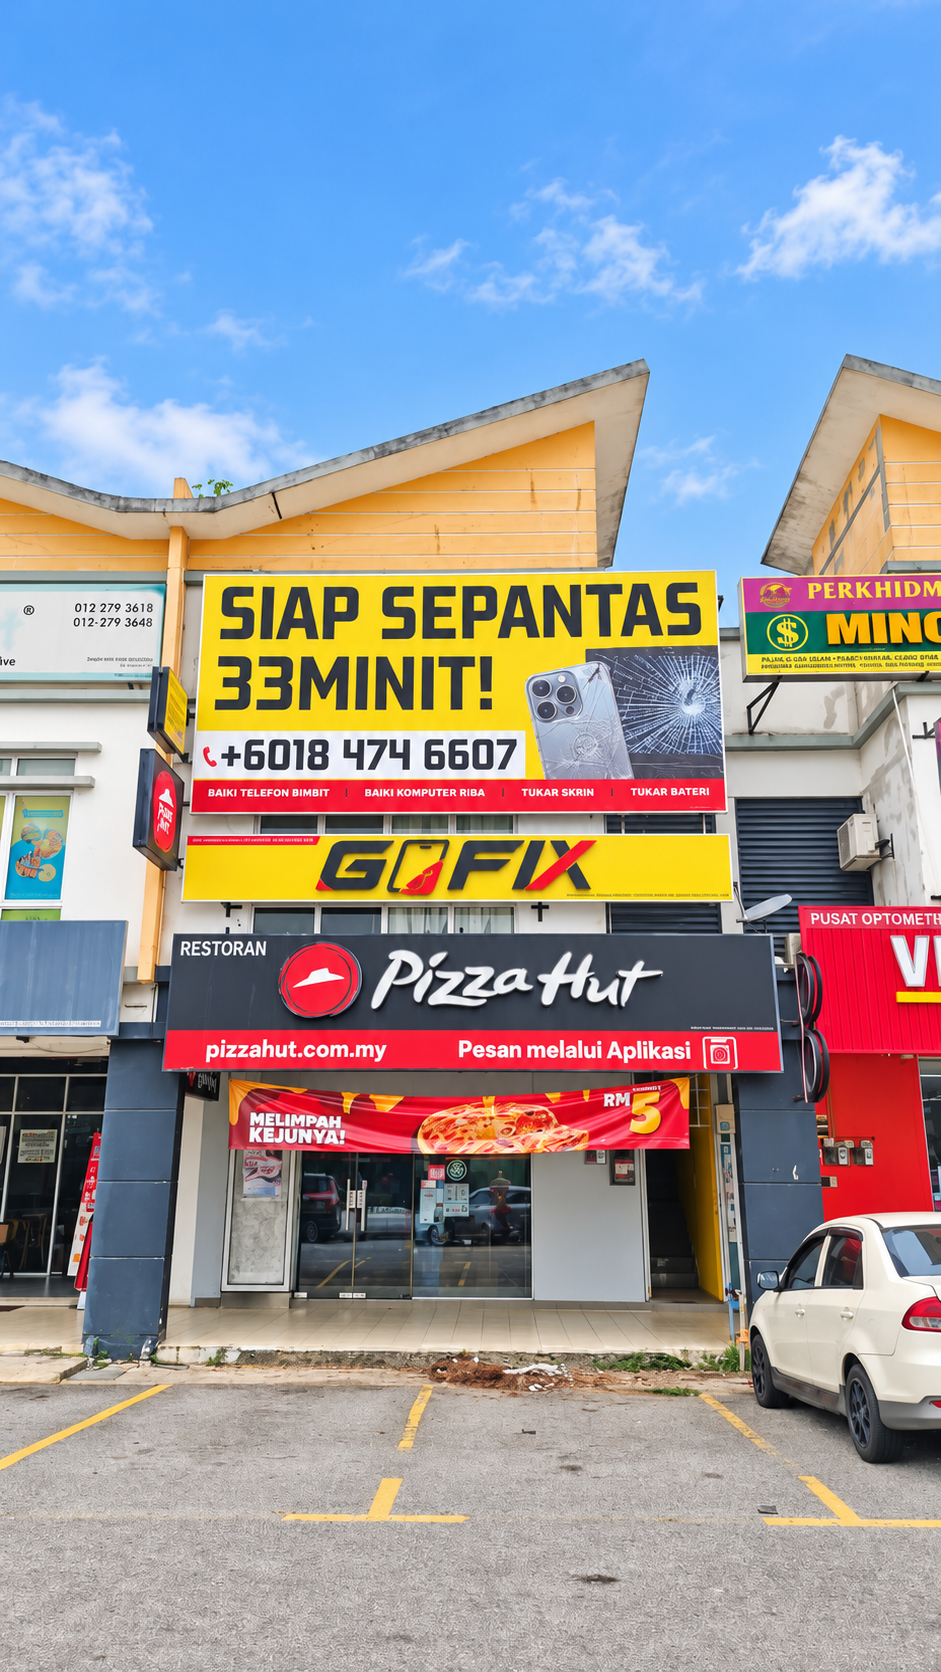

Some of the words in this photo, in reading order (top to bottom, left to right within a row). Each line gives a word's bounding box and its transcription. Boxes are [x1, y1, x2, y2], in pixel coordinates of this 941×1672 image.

[74, 603, 96, 613] 012
[100, 603, 121, 613] 279
[125, 603, 154, 613] 3618
[220, 586, 359, 640] SIAP
[382, 582, 701, 640] SEPANTAS
[124, 617, 153, 628] 3648
[214, 656, 492, 711] 33MINIT!
[221, 738, 330, 771] +6018
[343, 738, 411, 771] 474
[424, 738, 517, 771] 6607
[208, 788, 238, 798] BAIKI
[240, 788, 289, 798] TELEFON
[292, 788, 330, 798] BIMBIT
[364, 788, 394, 798] BAIKI
[397, 788, 457, 798] KOMPUTER
[459, 788, 485, 798] RIBA
[522, 788, 559, 798] TUKAR
[561, 788, 595, 798] SKRIN
[631, 787, 668, 797] TUKAR
[671, 787, 710, 797] BATERI
[810, 912, 858, 925] PUSAT
[180, 940, 267, 957] RESTORAN
[371, 949, 534, 1010] Pizza
[537, 951, 664, 1008] Hut
[205, 1039, 388, 1063] pizzahut.com.my
[458, 1039, 522, 1059] Pesan
[526, 1039, 603, 1059] melalui
[606, 1040, 692, 1064] Aplikasi
[249, 1112, 342, 1129] MELIMPAH
[603, 1092, 631, 1107] RM
[630, 1091, 662, 1135] 5
[248, 1127, 346, 1145] KEJUNYA!
